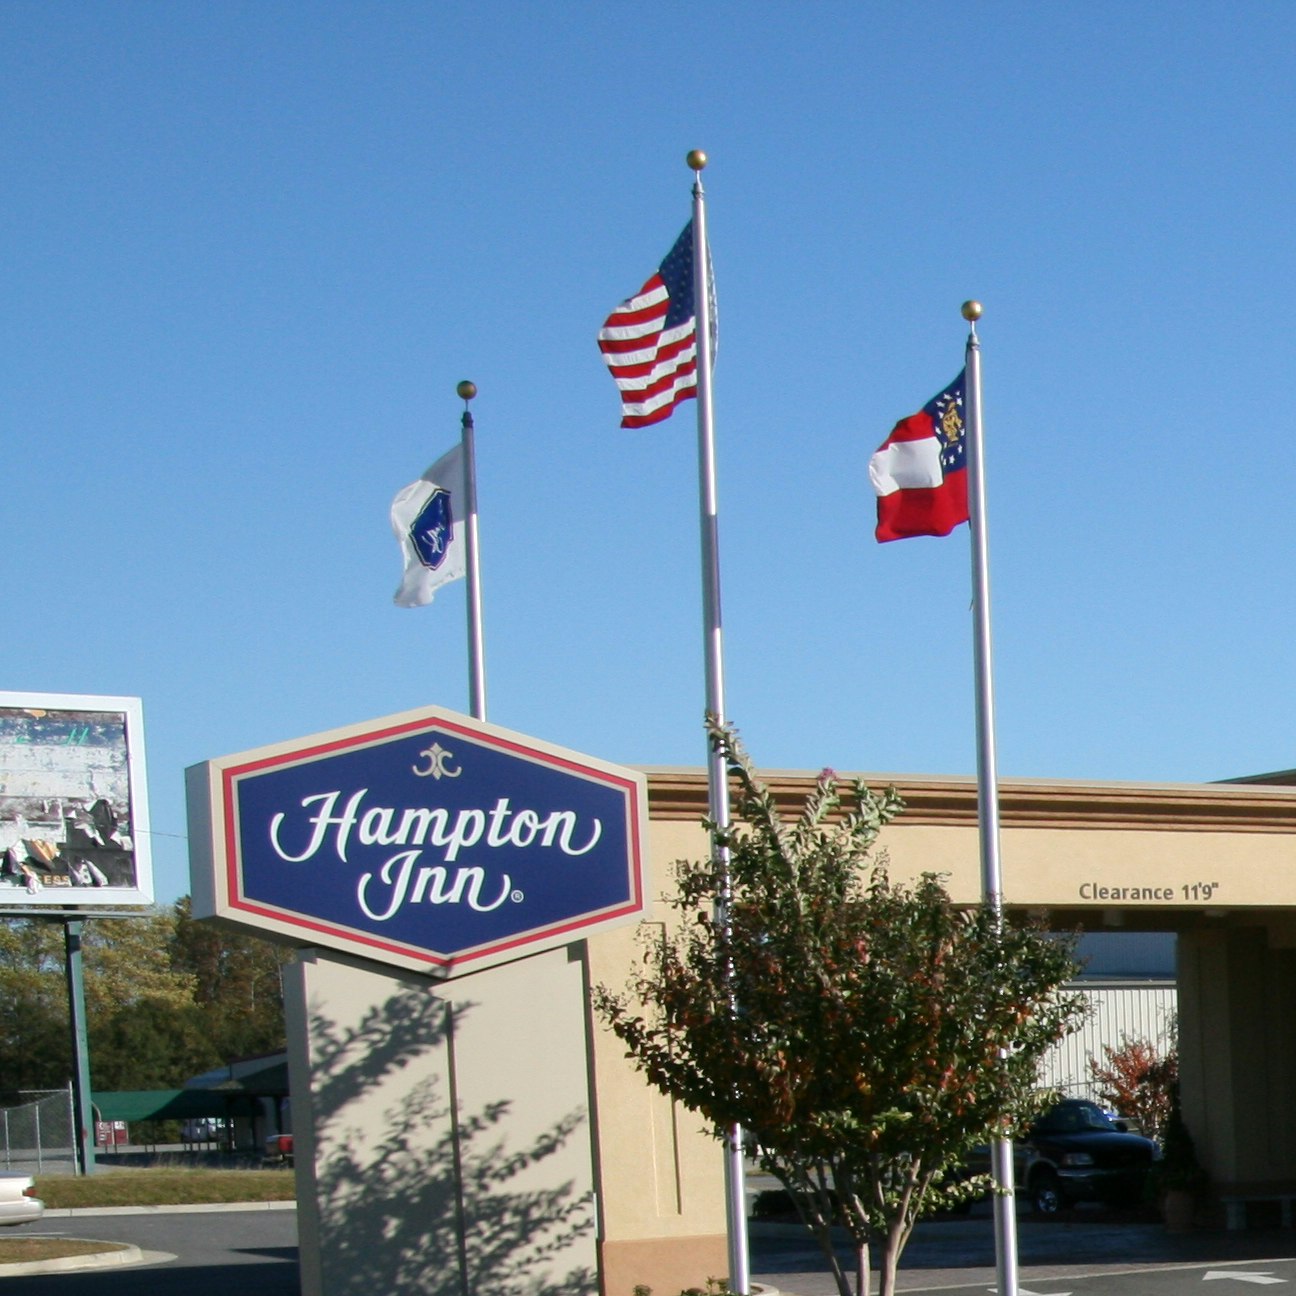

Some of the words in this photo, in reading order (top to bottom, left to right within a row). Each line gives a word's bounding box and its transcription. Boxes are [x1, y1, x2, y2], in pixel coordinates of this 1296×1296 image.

[269, 788, 602, 863] Hampton
[356, 849, 512, 922] Inn
[1079, 882, 1175, 901] Clearance
[1181, 881, 1220, 901] 11'9"
